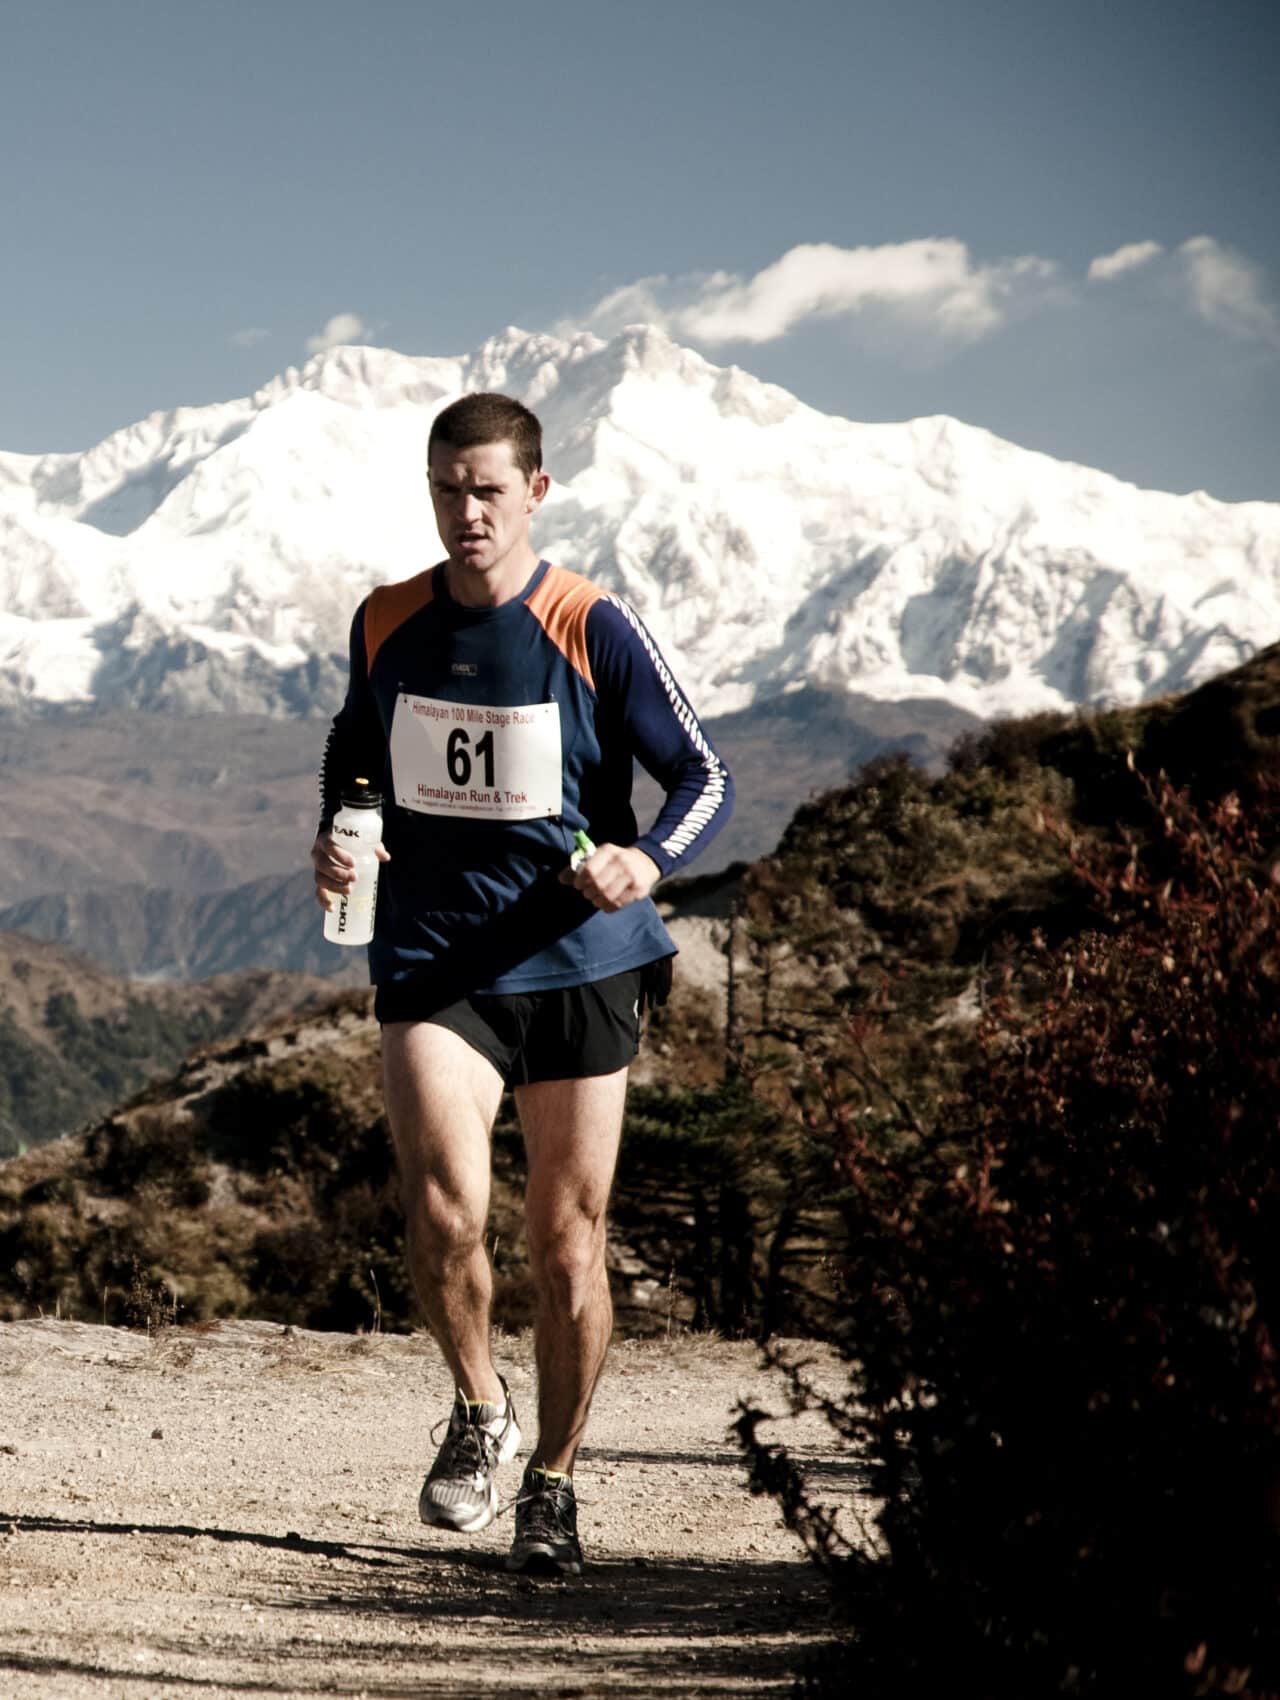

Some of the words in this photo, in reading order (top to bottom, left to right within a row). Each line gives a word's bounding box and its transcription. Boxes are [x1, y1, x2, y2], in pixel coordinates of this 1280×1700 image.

[413, 702, 449, 721] Himalayan
[451, 707, 465, 721] 100
[467, 709, 484, 723] Mile
[486, 711, 511, 728] Stage
[513, 711, 535, 724] Race
[446, 728, 495, 787] 61
[417, 784, 467, 802] Himalayan
[470, 789, 490, 803] Run
[493, 791, 501, 803] &
[504, 791, 528, 803] Trek
